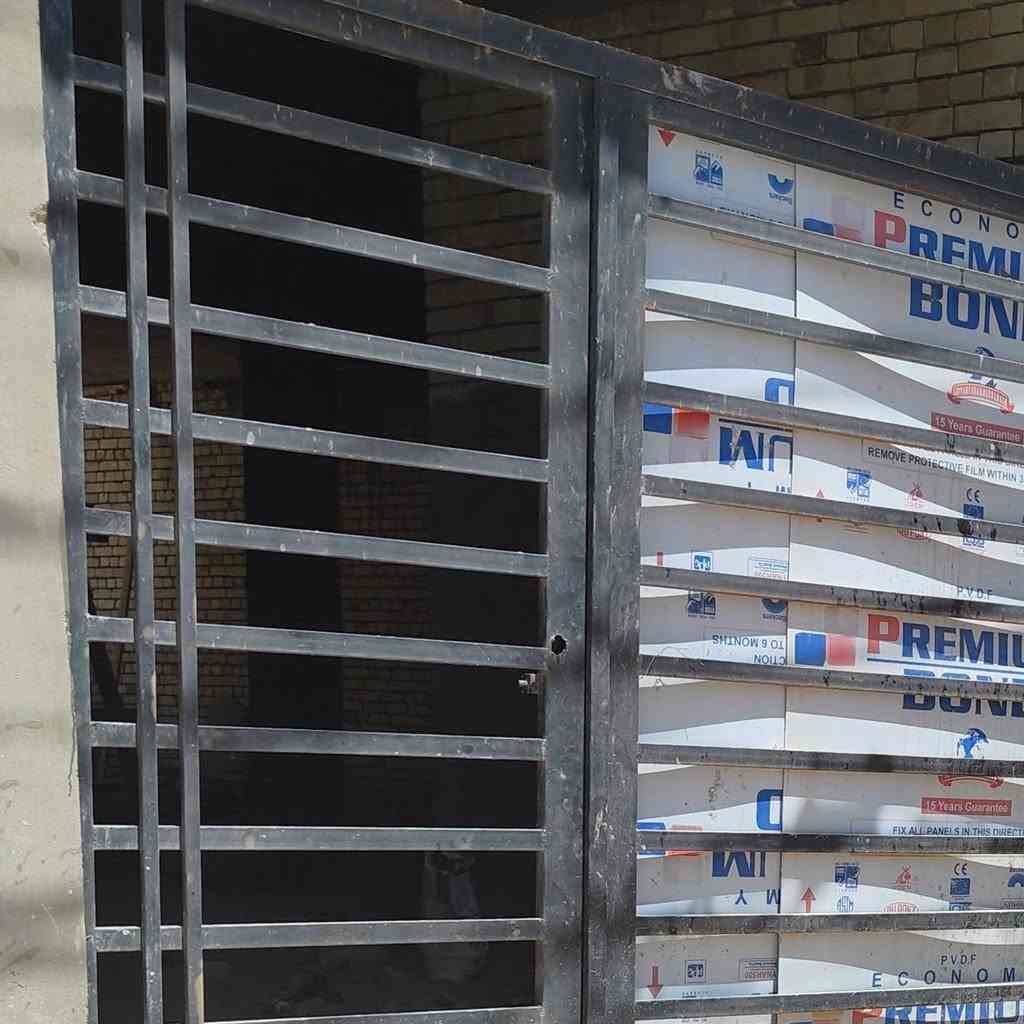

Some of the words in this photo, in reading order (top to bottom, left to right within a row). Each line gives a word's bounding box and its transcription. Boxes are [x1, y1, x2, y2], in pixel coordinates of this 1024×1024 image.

[949, 419, 974, 434] Years
[975, 425, 1021, 442] Guarantee
[867, 447, 907, 464] REMOVE
[908, 454, 963, 474] PROTECTIVE
[965, 464, 985, 478] FILM
[986, 468, 1017, 484] WITHIN
[937, 800, 962, 812] Years
[964, 802, 1009, 813] Guarantee
[892, 825, 908, 836] FIX
[909, 825, 925, 836] ALL
[926, 825, 960, 836] PANELS
[962, 826, 969, 836] IN
[970, 826, 991, 836] THIS
